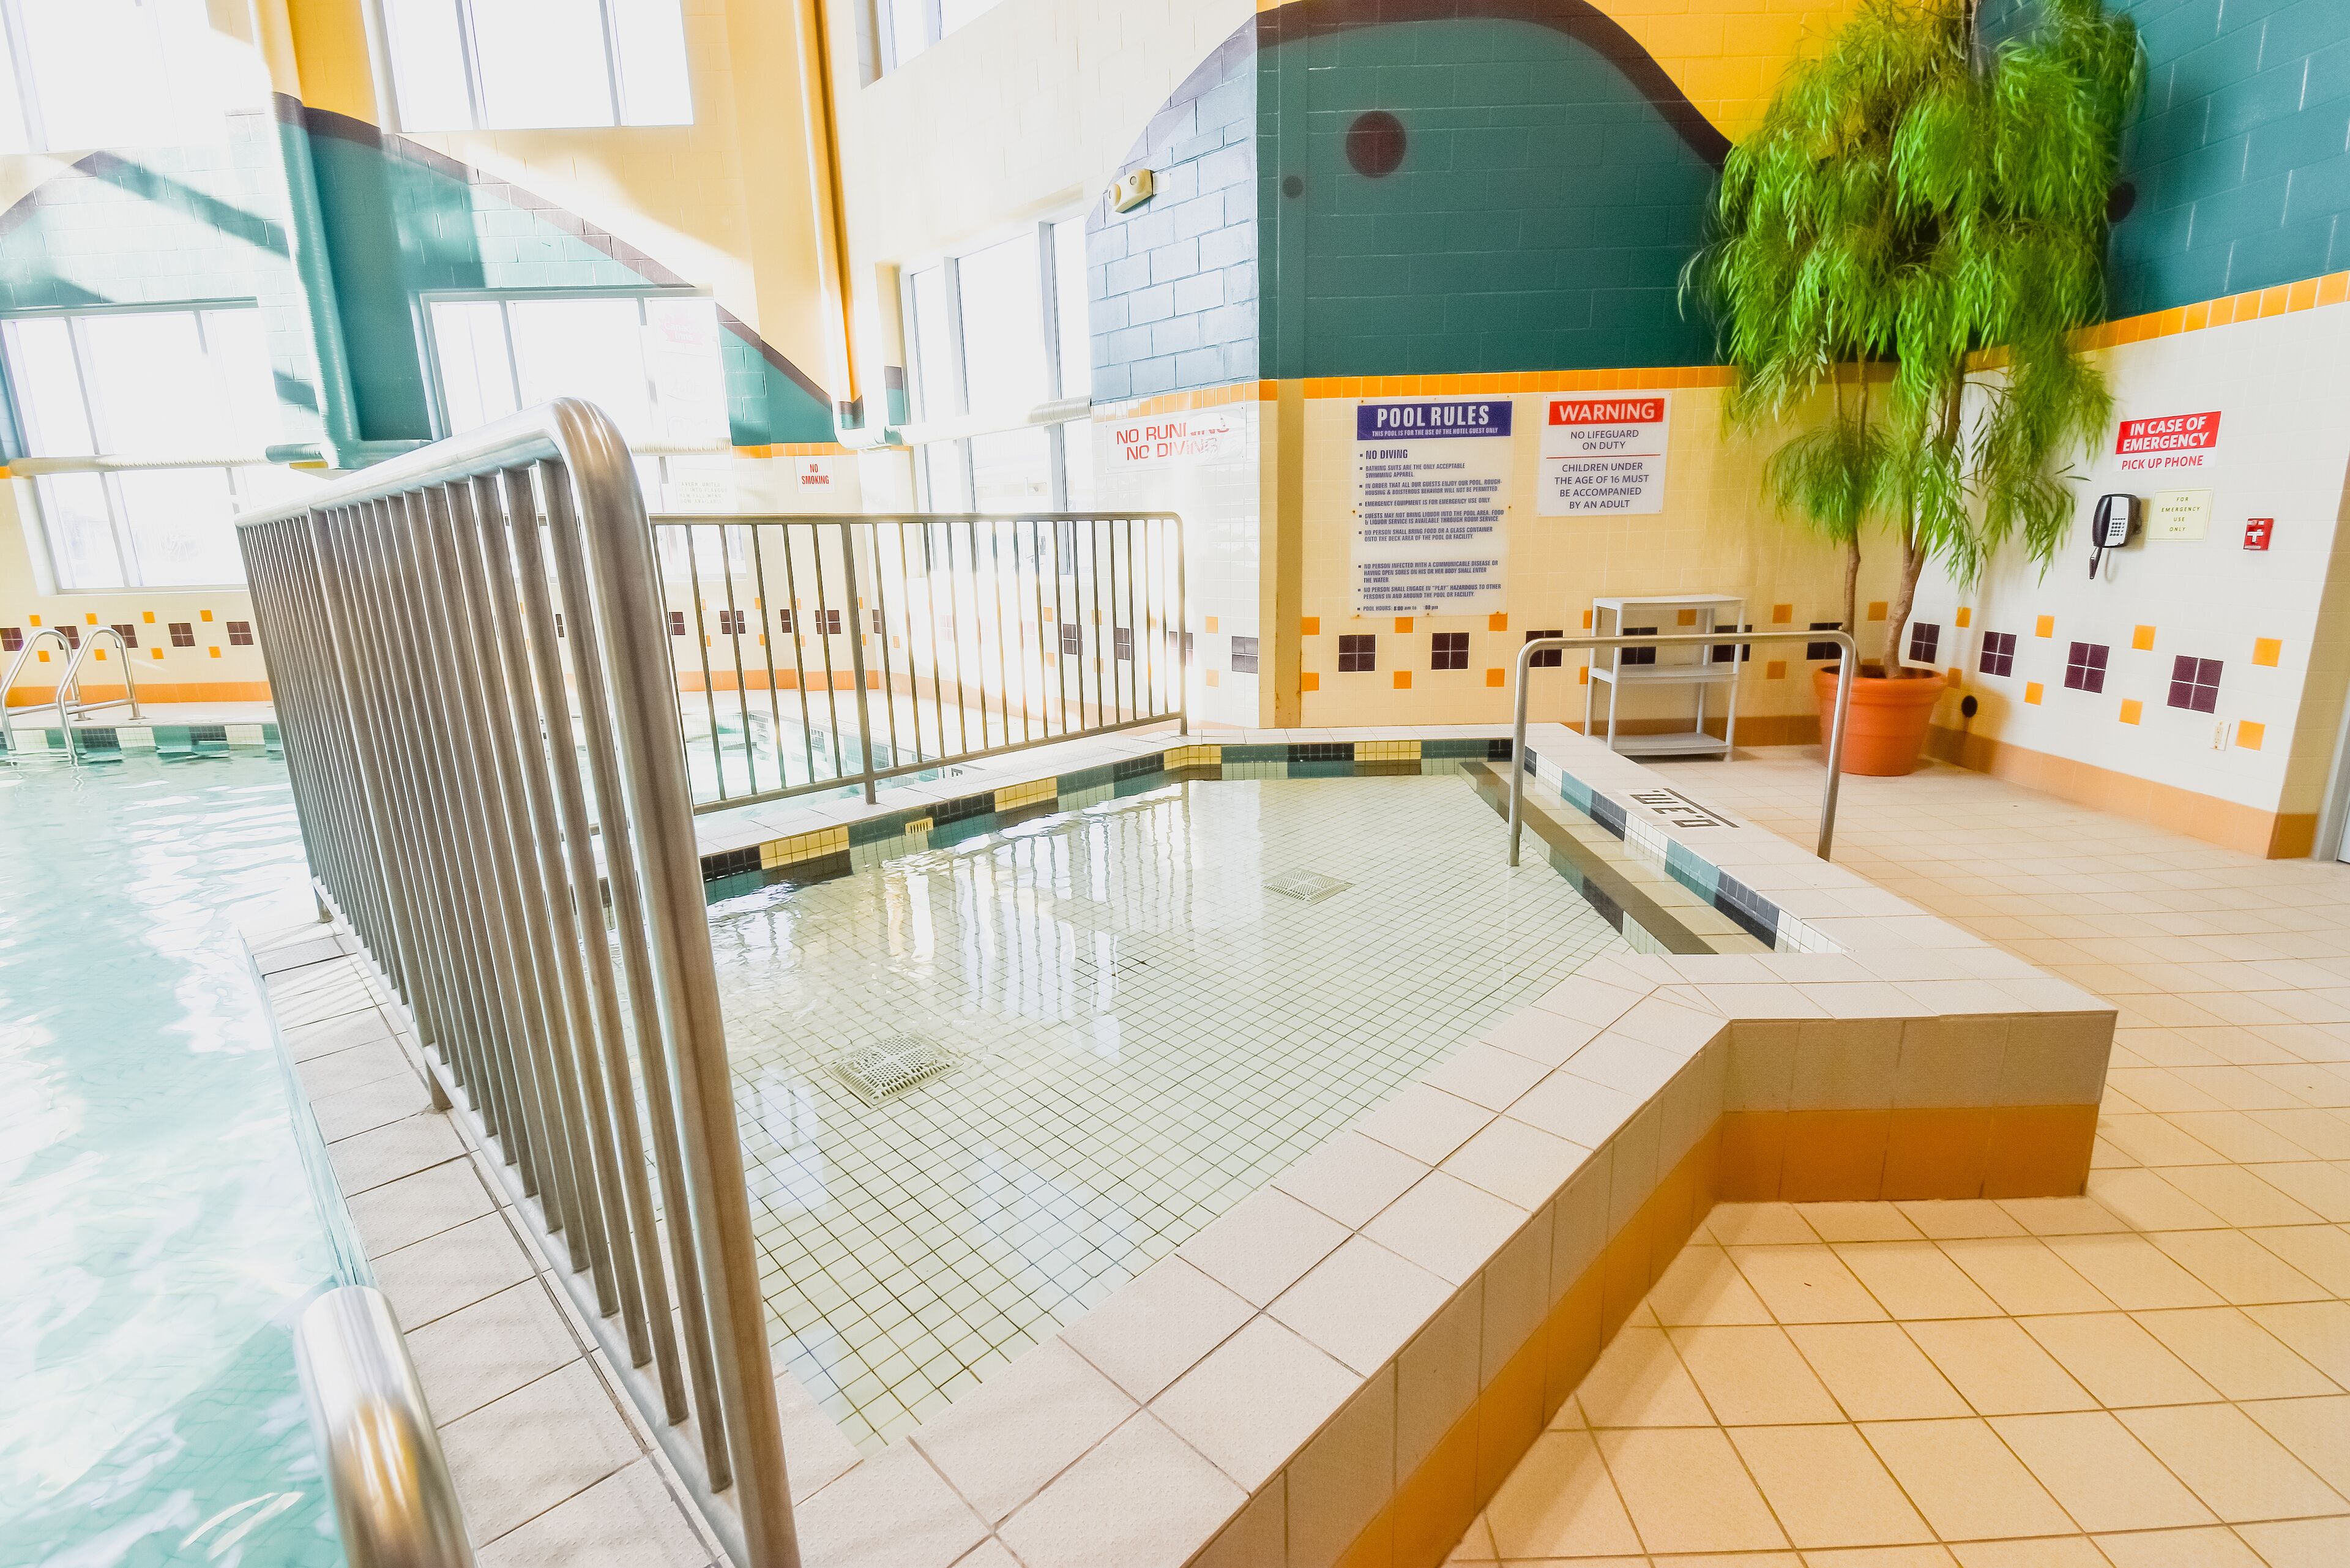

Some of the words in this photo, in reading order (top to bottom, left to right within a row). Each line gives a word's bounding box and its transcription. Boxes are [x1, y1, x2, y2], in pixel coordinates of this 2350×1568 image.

[1377, 407, 1425, 428] POOL
[1431, 405, 1489, 426] RULES
[1559, 402, 1655, 422] WARNING
[2130, 423, 2144, 436] IN
[2147, 420, 2183, 435] CASE
[2186, 416, 2207, 431] OF
[1116, 428, 1140, 444] NO
[1570, 431, 1584, 439] NO
[1587, 430, 1639, 439] LIFEGUARD
[2122, 431, 2209, 452] EMERGENCY
[1127, 445, 1149, 460] NO
[1366, 450, 1377, 460] NO
[1380, 449, 1408, 459] DIVING
[810, 463, 818, 473] NO
[1562, 463, 1608, 472] CHILDREN
[2122, 458, 2144, 471] PICK
[2147, 457, 2162, 469] UP
[2164, 455, 2203, 468] PHONE
[801, 475, 829, 485] SMOKING
[1622, 474, 1649, 483] MUST
[1573, 488, 1641, 496] ACCOMPANIED
